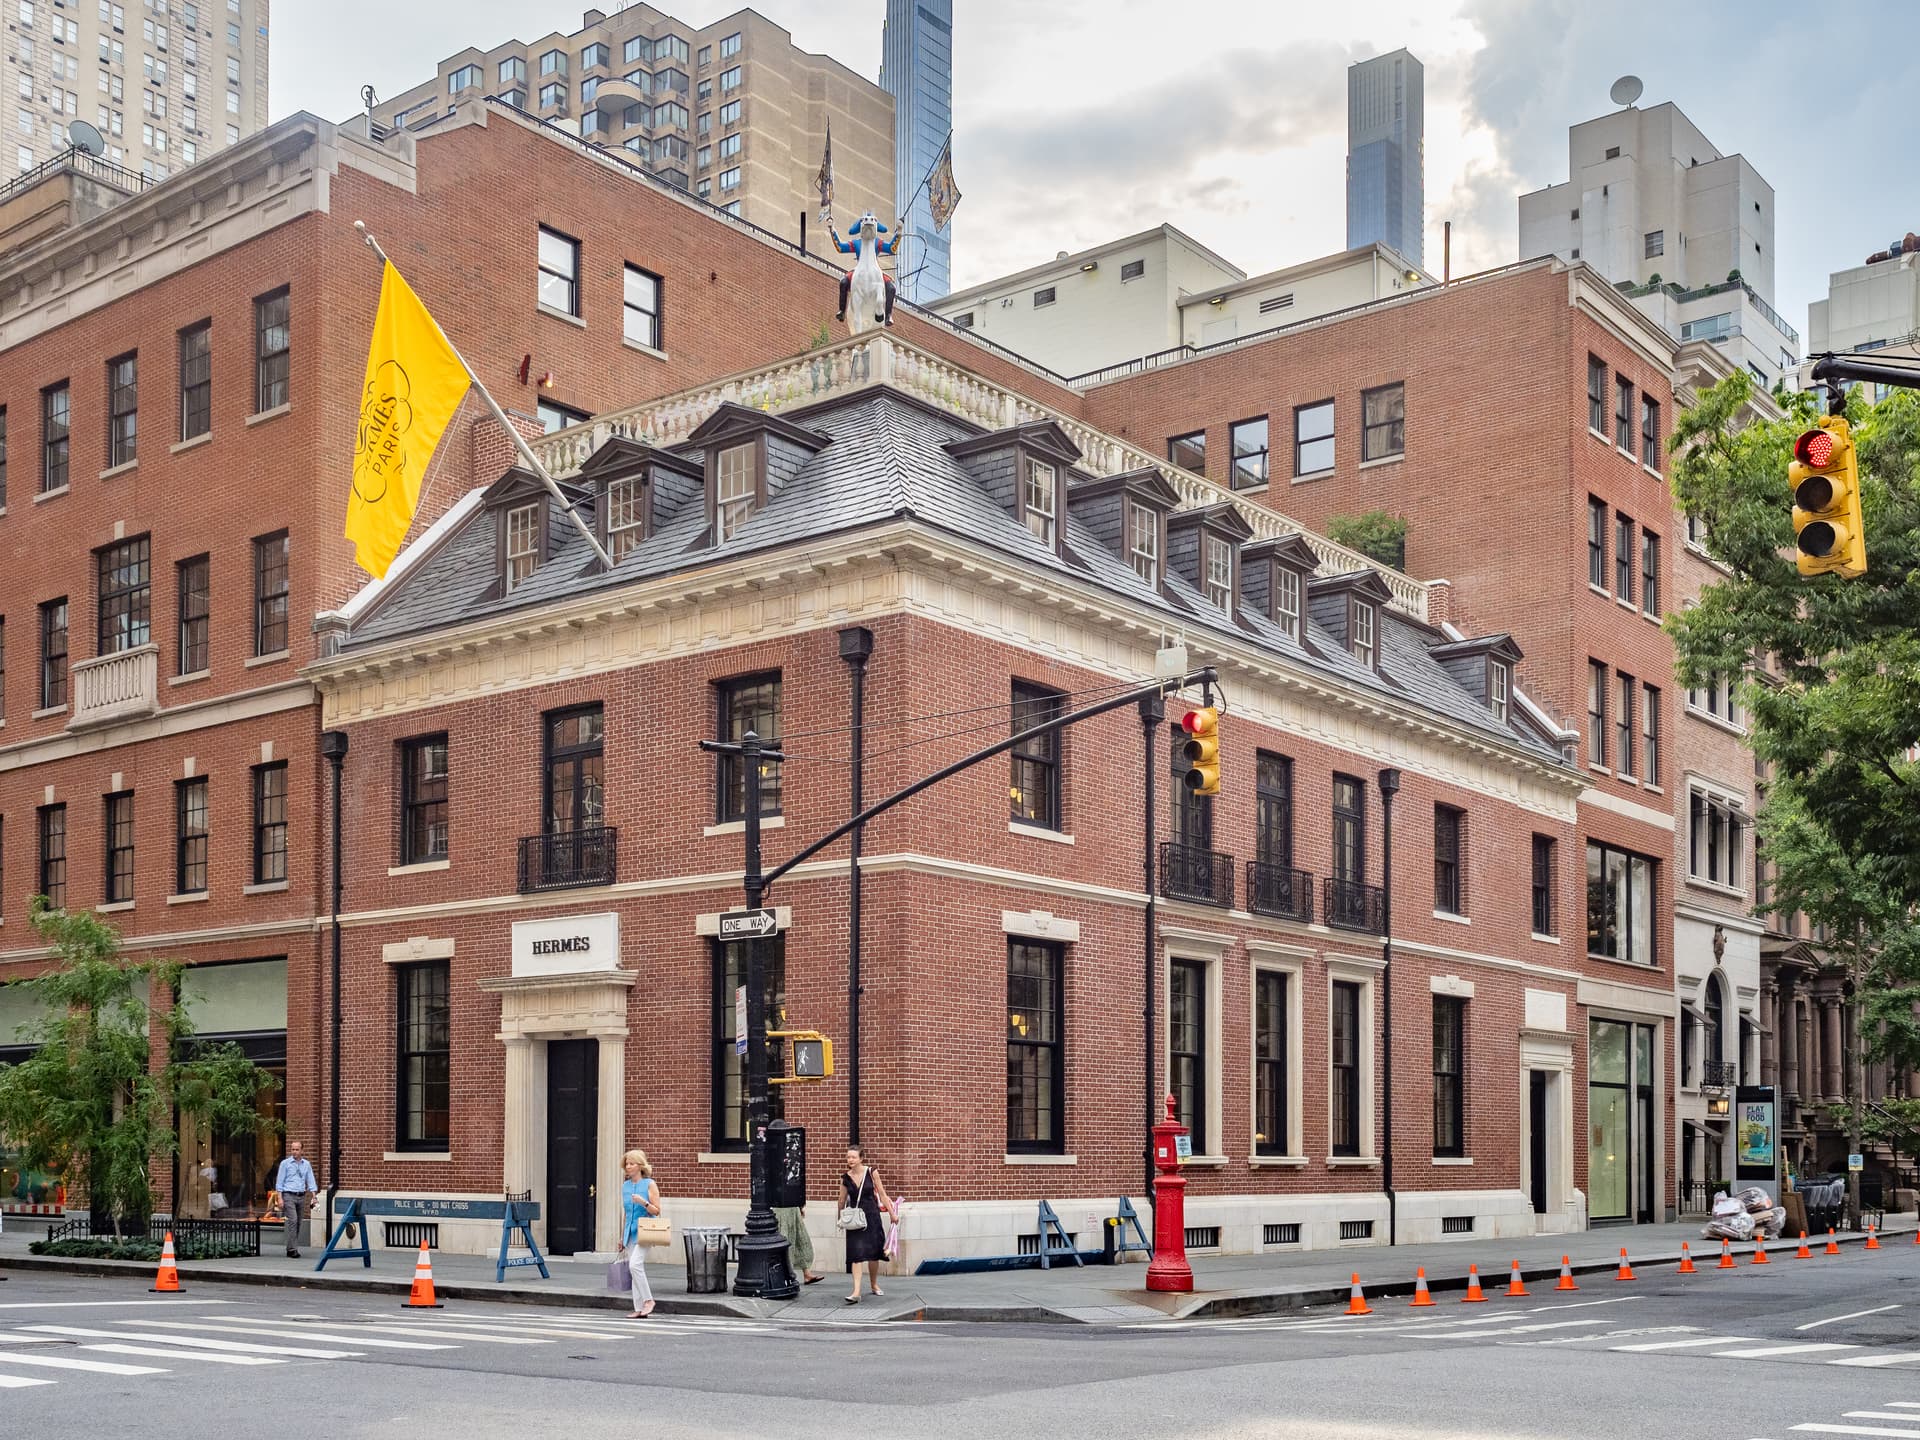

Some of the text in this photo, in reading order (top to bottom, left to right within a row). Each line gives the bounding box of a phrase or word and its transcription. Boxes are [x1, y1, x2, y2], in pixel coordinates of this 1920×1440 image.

[725, 917, 769, 931] ONE WAY
[532, 936, 590, 955] HERMÈS
[394, 1200, 411, 1209] POLICE
[414, 1201, 425, 1209] LINE
[432, 1201, 439, 1209] DO
[451, 1202, 469, 1210] CROSS
